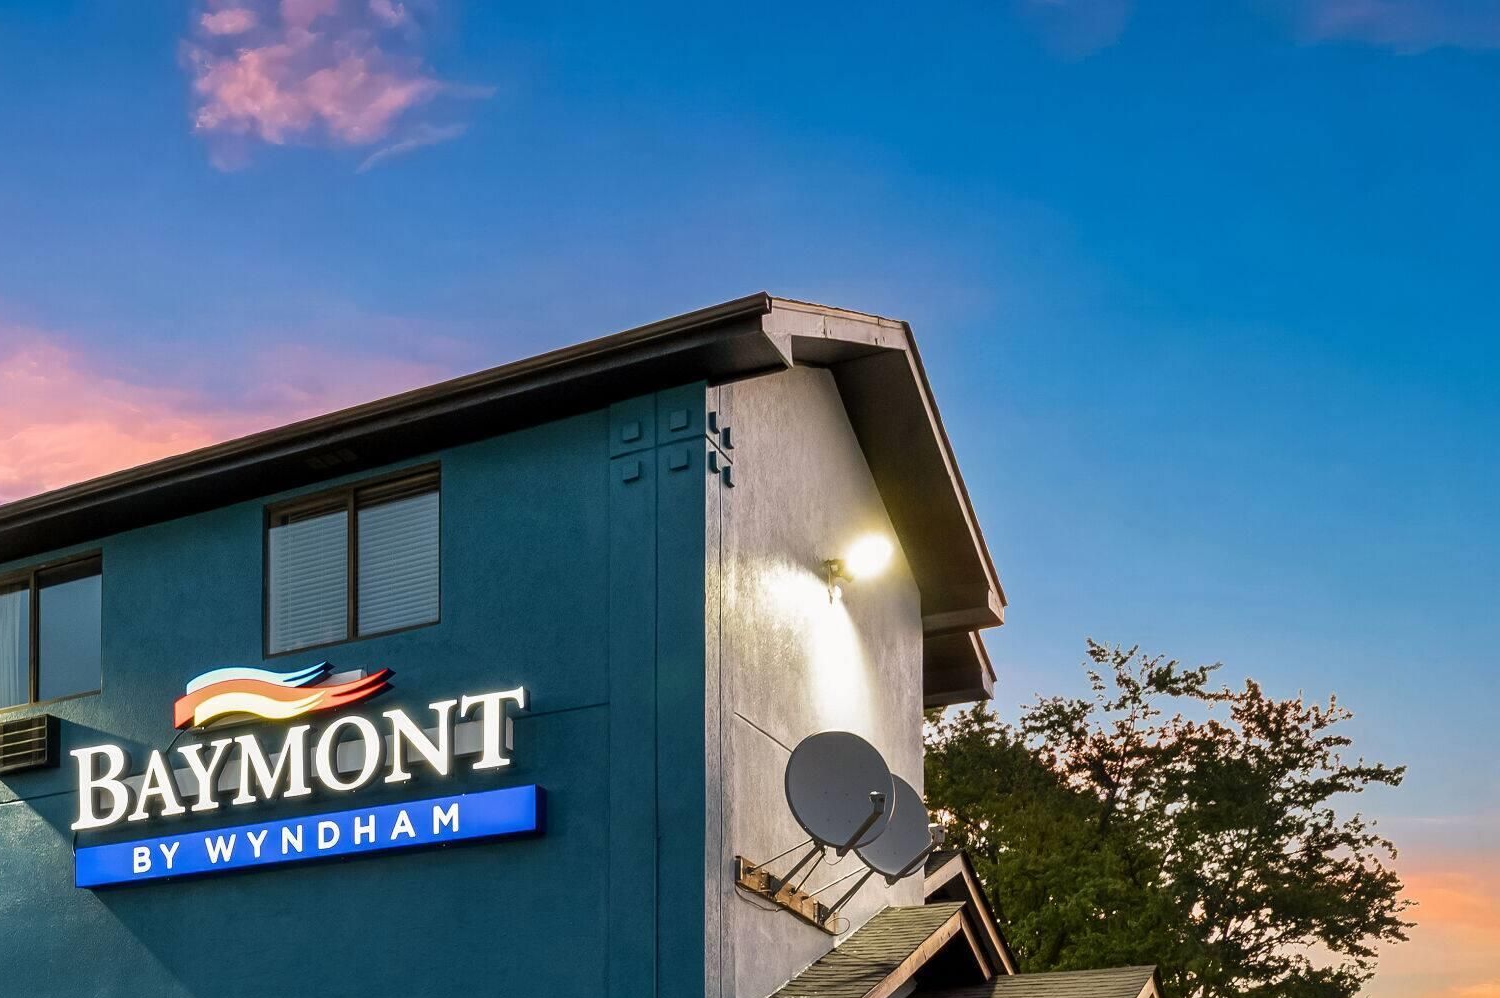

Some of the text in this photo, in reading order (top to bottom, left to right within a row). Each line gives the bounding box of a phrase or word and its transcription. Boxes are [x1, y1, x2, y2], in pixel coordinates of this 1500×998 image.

[71, 686, 524, 831] BAYMONT
[132, 803, 460, 874] BY WYNDHAM
